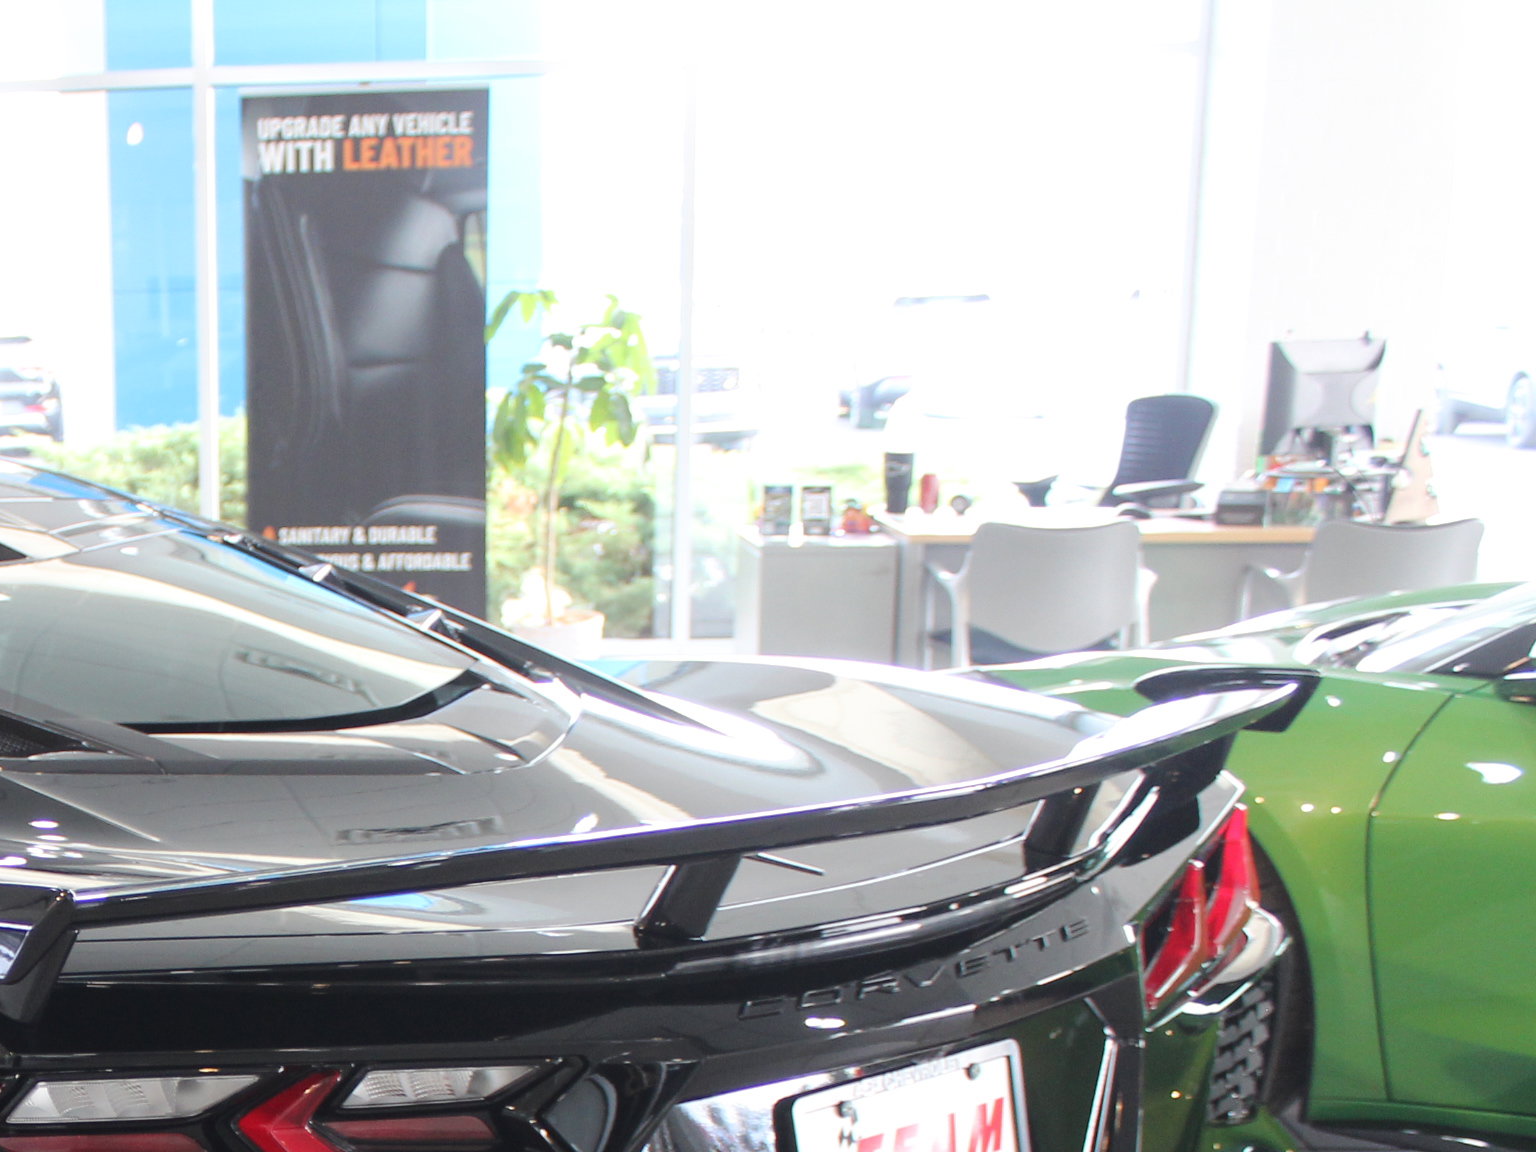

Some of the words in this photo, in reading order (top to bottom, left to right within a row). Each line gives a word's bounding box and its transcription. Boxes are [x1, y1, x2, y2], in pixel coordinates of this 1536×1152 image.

[257, 115, 346, 140] UPGRADE
[348, 113, 390, 137] ANY
[392, 111, 474, 136] VEHICLE
[259, 139, 335, 174] WITH
[343, 135, 473, 171] LEATHER
[278, 526, 351, 545] SANITARY
[352, 526, 367, 544] &
[368, 525, 437, 545] DURABLE
[361, 552, 375, 571] &
[377, 551, 472, 571] AFFORDABLE
[737, 918, 1090, 1021] CORVETTE
